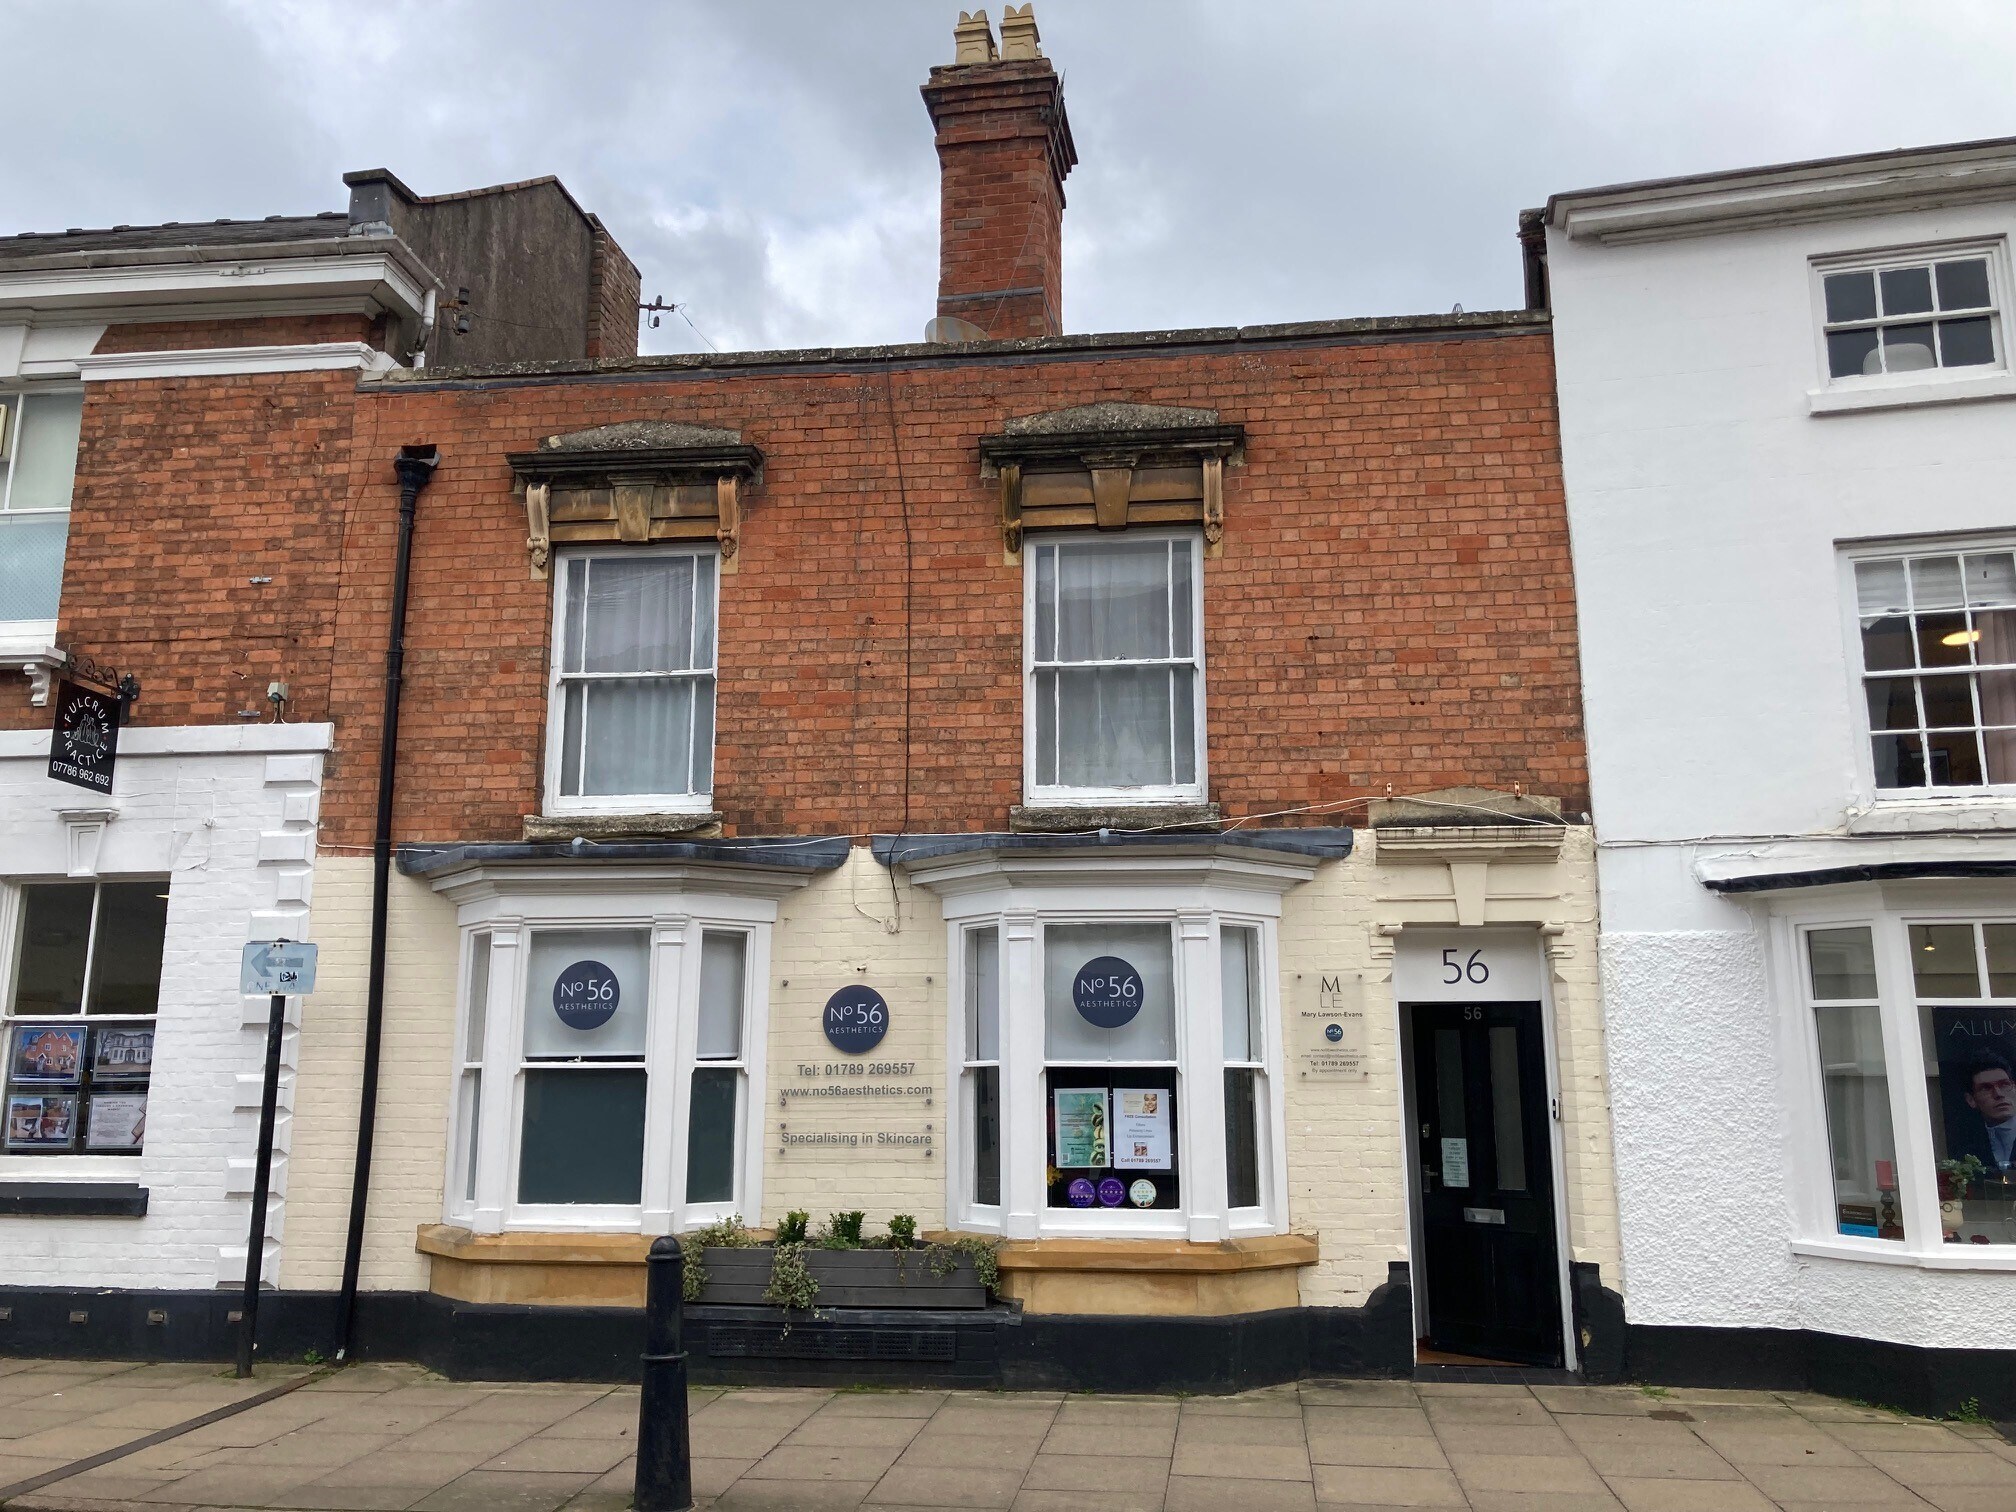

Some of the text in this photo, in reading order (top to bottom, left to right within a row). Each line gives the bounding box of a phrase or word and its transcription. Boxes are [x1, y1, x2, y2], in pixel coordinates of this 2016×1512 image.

[64, 696, 109, 734] FULCRUM
[62, 730, 108, 766] PRACTICE
[52, 760, 110, 786] 07786 962 692
[1442, 948, 1489, 985] 56
[587, 979, 613, 1001] 56
[1109, 975, 1136, 998] 56
[1321, 975, 1341, 993] M
[559, 1002, 613, 1011] AESTHETICS
[856, 1002, 882, 1024] 56
[1080, 1000, 1138, 1008] AESTHETICS
[1464, 1006, 1482, 1020] 56
[829, 1026, 883, 1035] AESTHETICS
[797, 1062, 915, 1076] Tel: 01789 269557
[780, 1084, 933, 1097] www.no56aesthetics.com
[781, 1132, 932, 1146] Specialising in Skincare
